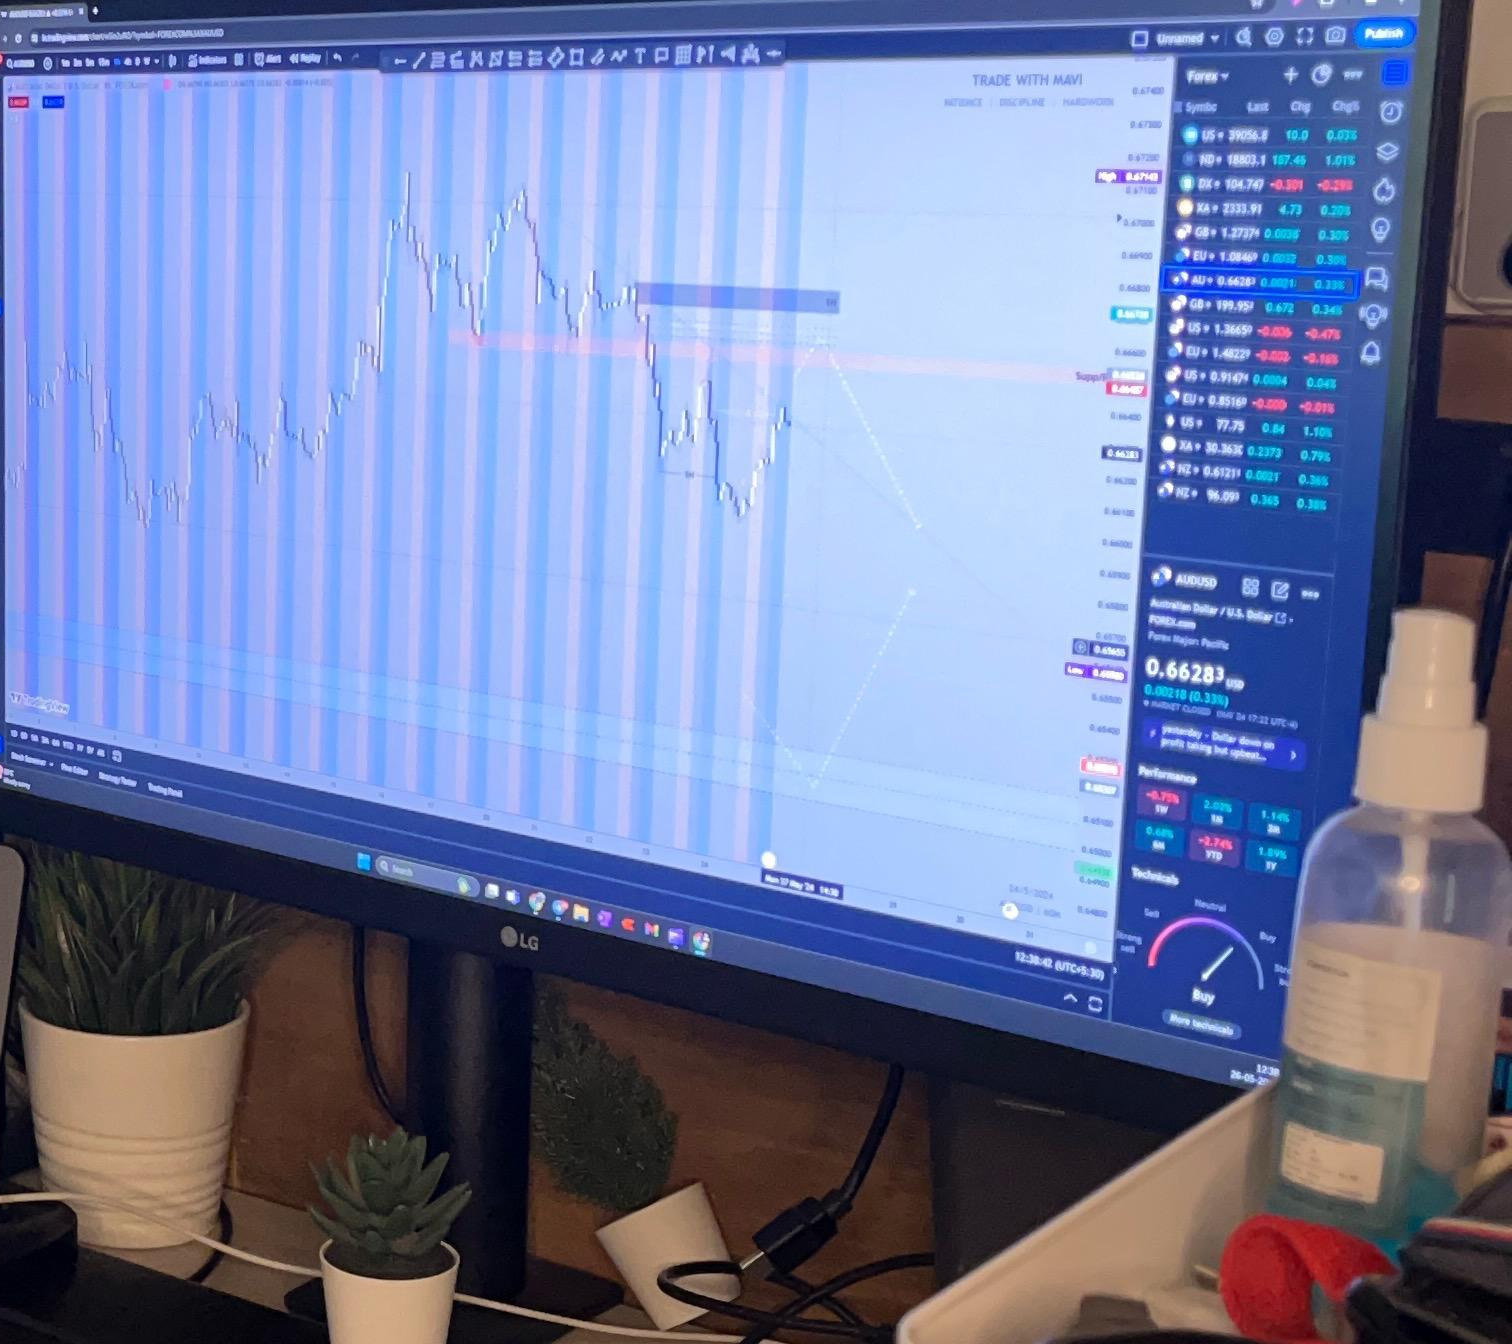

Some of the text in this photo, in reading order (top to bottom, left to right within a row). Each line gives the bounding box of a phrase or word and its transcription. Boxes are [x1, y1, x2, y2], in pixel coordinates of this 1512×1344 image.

[1157, 32, 1204, 46] Unnamed
[972, 72, 1083, 88] TRADE WITH MAVI
[1186, 70, 1219, 84] Forex
[1246, 101, 1312, 116] Last Chg
[1286, 129, 1309, 142] 10.0
[1197, 178, 1213, 191] DX
[1279, 204, 1303, 216] 4.73
[1265, 302, 1295, 314] 0.672
[1216, 418, 1245, 433] 77.75
[1250, 493, 1279, 507] 0.365
[1175, 574, 1218, 590] AUDUSD
[1149, 597, 1191, 612] Australian
[1193, 603, 1219, 617] Dollar
[1226, 606, 1245, 619] U.S.
[1246, 609, 1274, 624] Dollar
[1148, 614, 1197, 630] FOREX.com
[1145, 657, 1225, 686] 0.66283
[1225, 678, 1245, 692] USD
[1144, 683, 1230, 709] 0.00218 (0.33%)
[1161, 725, 1276, 751] yesterday Dollar down on
[1160, 737, 1185, 750] profit
[1186, 740, 1212, 755] taking
[1214, 745, 1229, 756] but
[1138, 764, 1198, 786] Performance
[1261, 809, 1290, 824] 1.14%
[1205, 850, 1224, 862] YTD
[1131, 864, 1180, 886] Technicals
[519, 933, 539, 952] LG
[1259, 931, 1278, 945] Buy
[1274, 963, 1292, 975] Stro
[1191, 987, 1216, 1007] Buy
